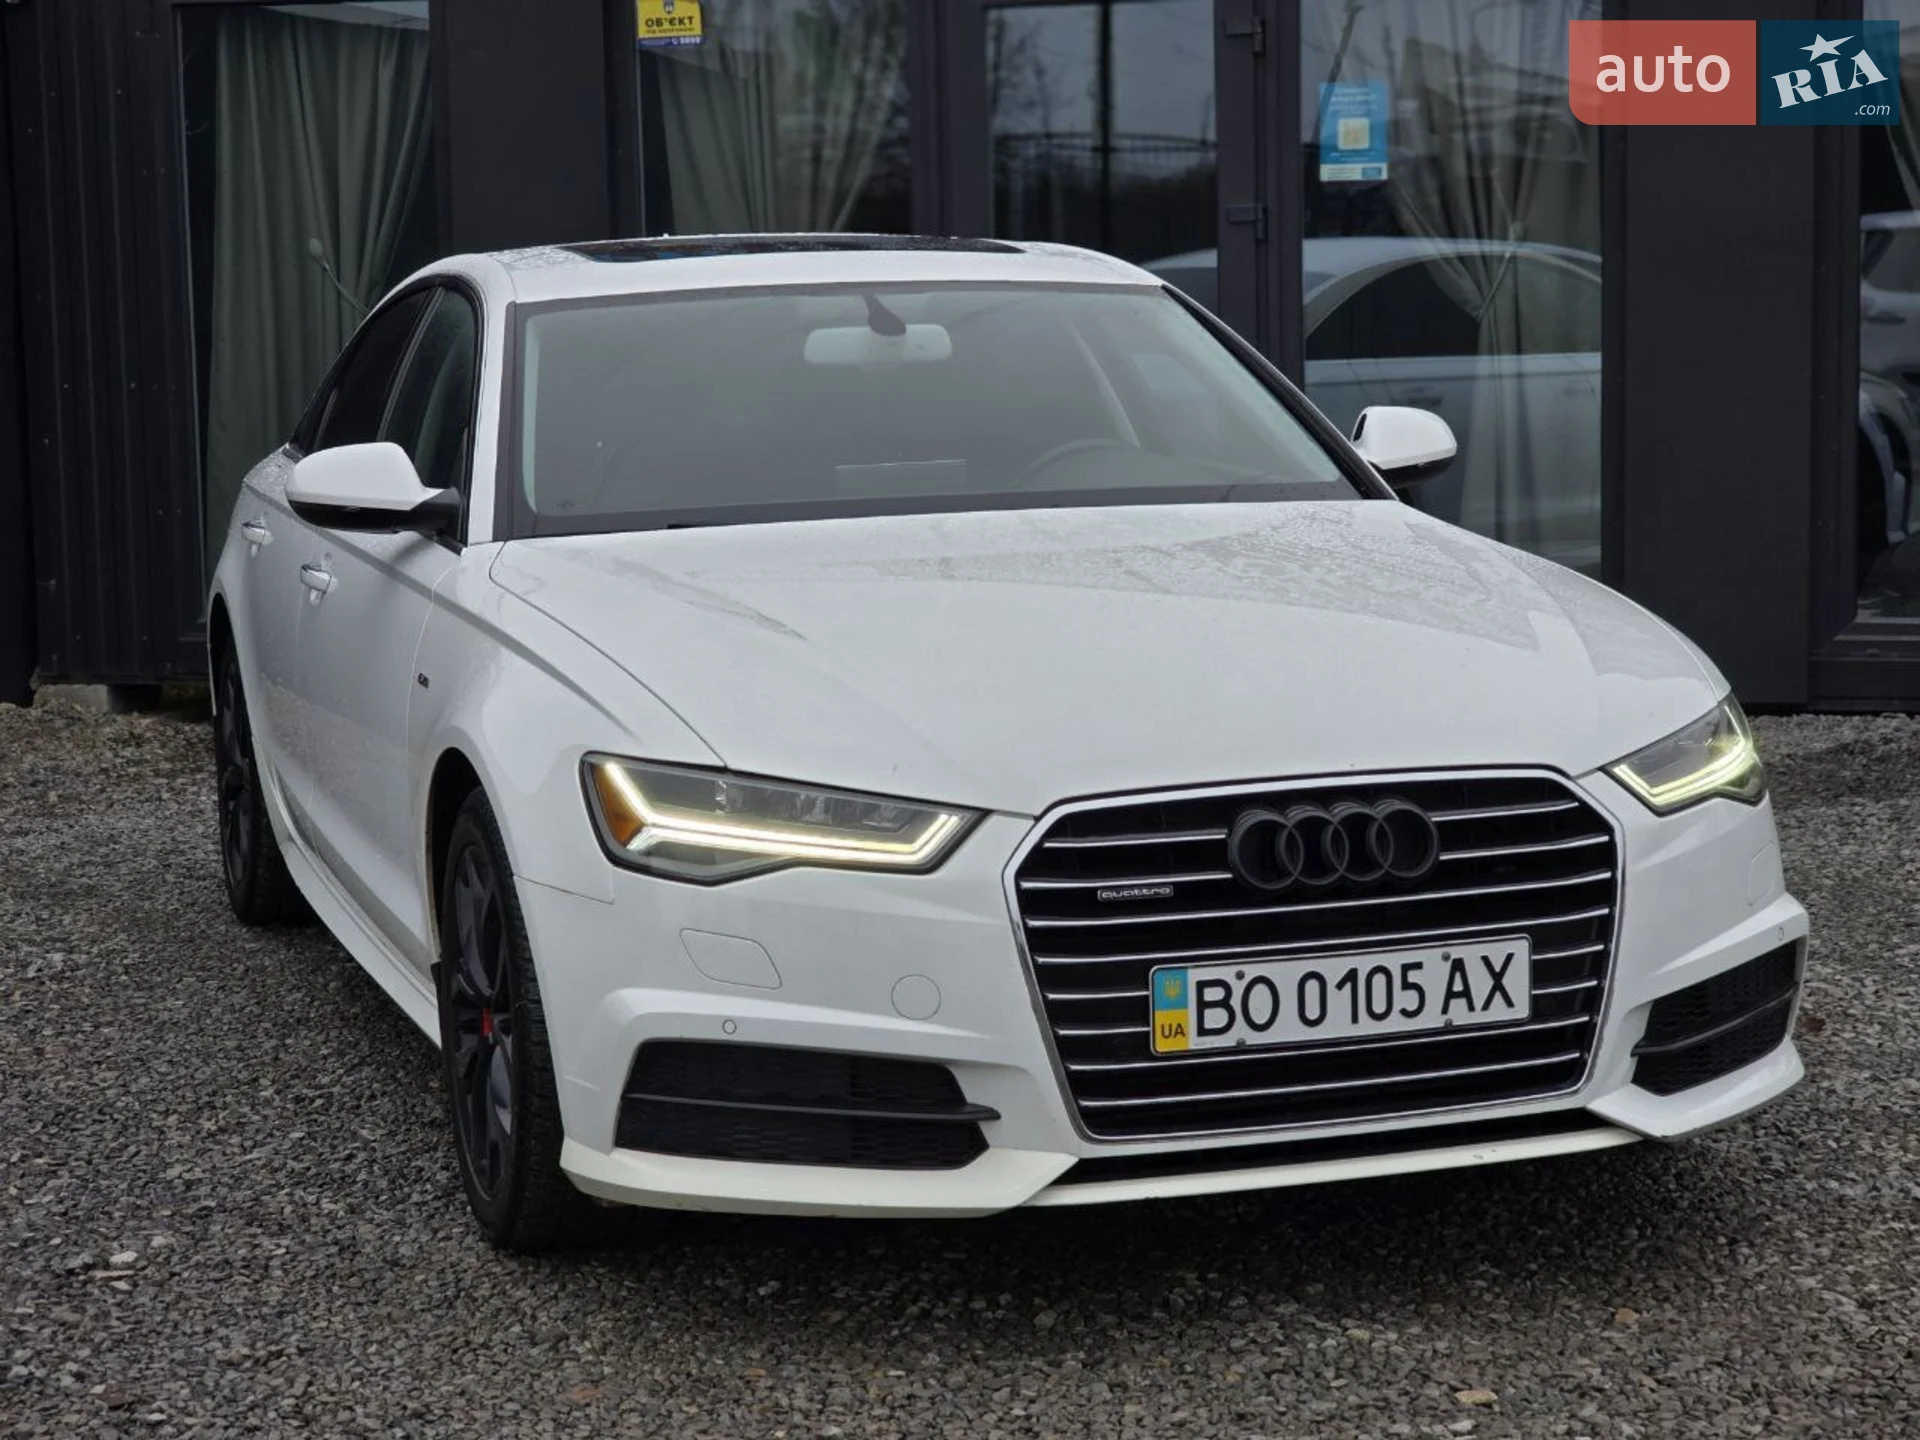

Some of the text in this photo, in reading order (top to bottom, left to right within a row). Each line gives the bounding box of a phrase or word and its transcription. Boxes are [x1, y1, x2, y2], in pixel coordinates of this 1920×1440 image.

[1101, 887, 1171, 899] quattro
[1195, 952, 1516, 1038] BO 0105 AX
[1161, 1022, 1186, 1040] UA
